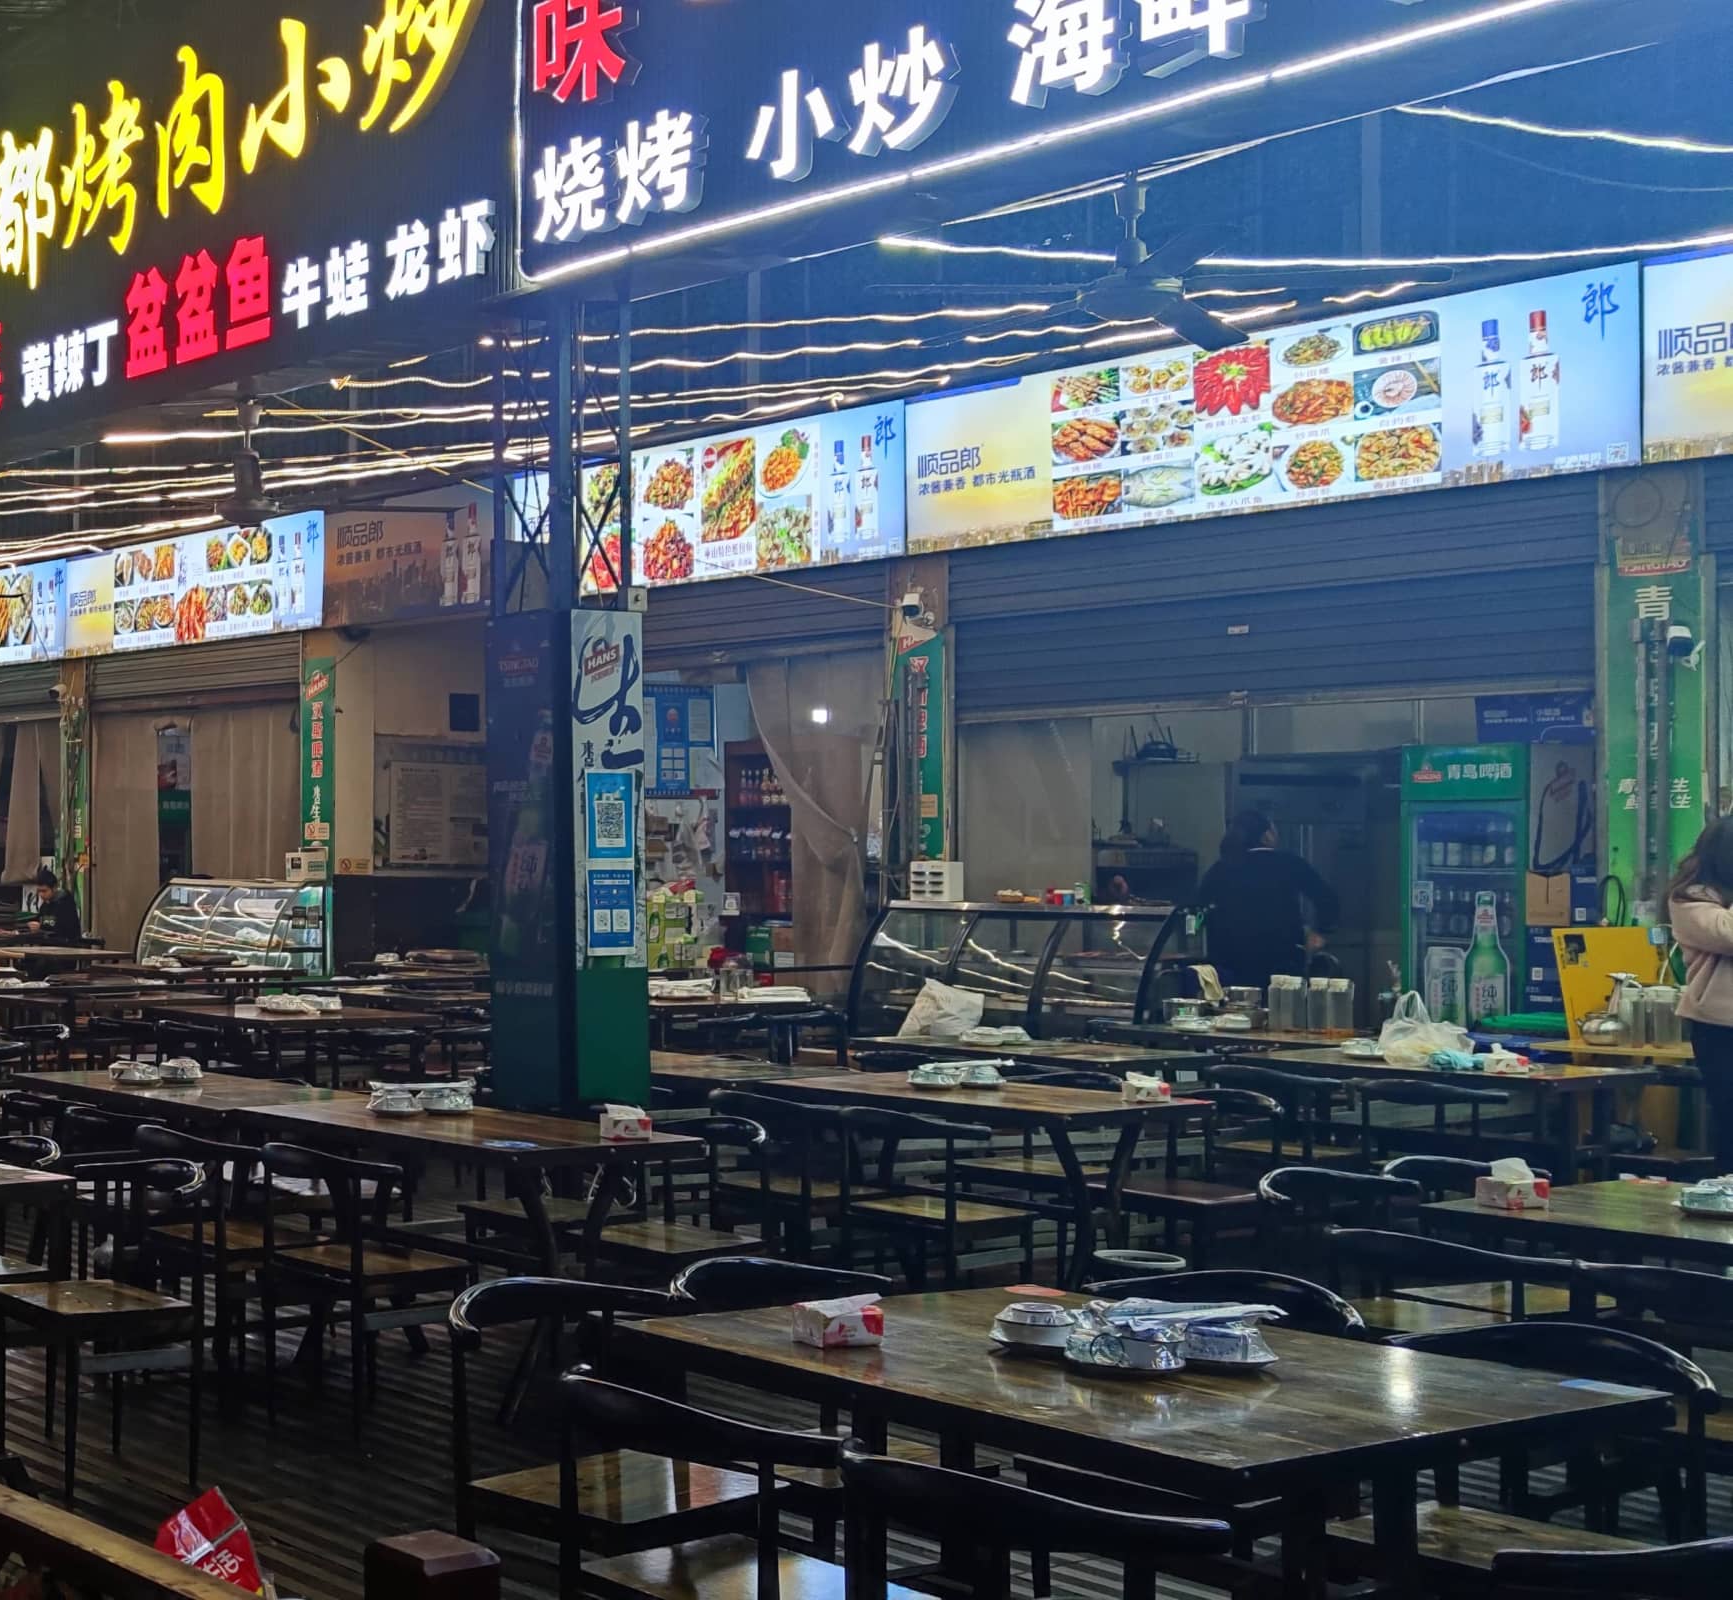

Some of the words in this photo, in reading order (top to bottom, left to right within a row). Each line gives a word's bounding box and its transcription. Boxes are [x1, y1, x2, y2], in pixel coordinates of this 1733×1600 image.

[533, 0, 625, 102] 味
[533, 109, 694, 244] 烧烤
[745, 25, 946, 179] 小炒
[20, 319, 118, 408] 黄辣丁
[125, 235, 272, 379] 盆盆鱼
[282, 240, 369, 328] 牛蛙
[384, 199, 493, 301] 龙虾
[1581, 281, 1620, 341] 郎
[1657, 321, 1733, 360] 顺品
[1656, 357, 1715, 377] 浓酱兼香
[874, 415, 897, 460] 郎
[917, 446, 982, 480] 顺品郎
[917, 476, 966, 497] 浓酱兼香
[972, 465, 1037, 489] 都市光瓶酒
[336, 520, 385, 549] 顺品郎
[586, 648, 617, 670] HANS
[1447, 763, 1513, 781] 青岛啤酒
